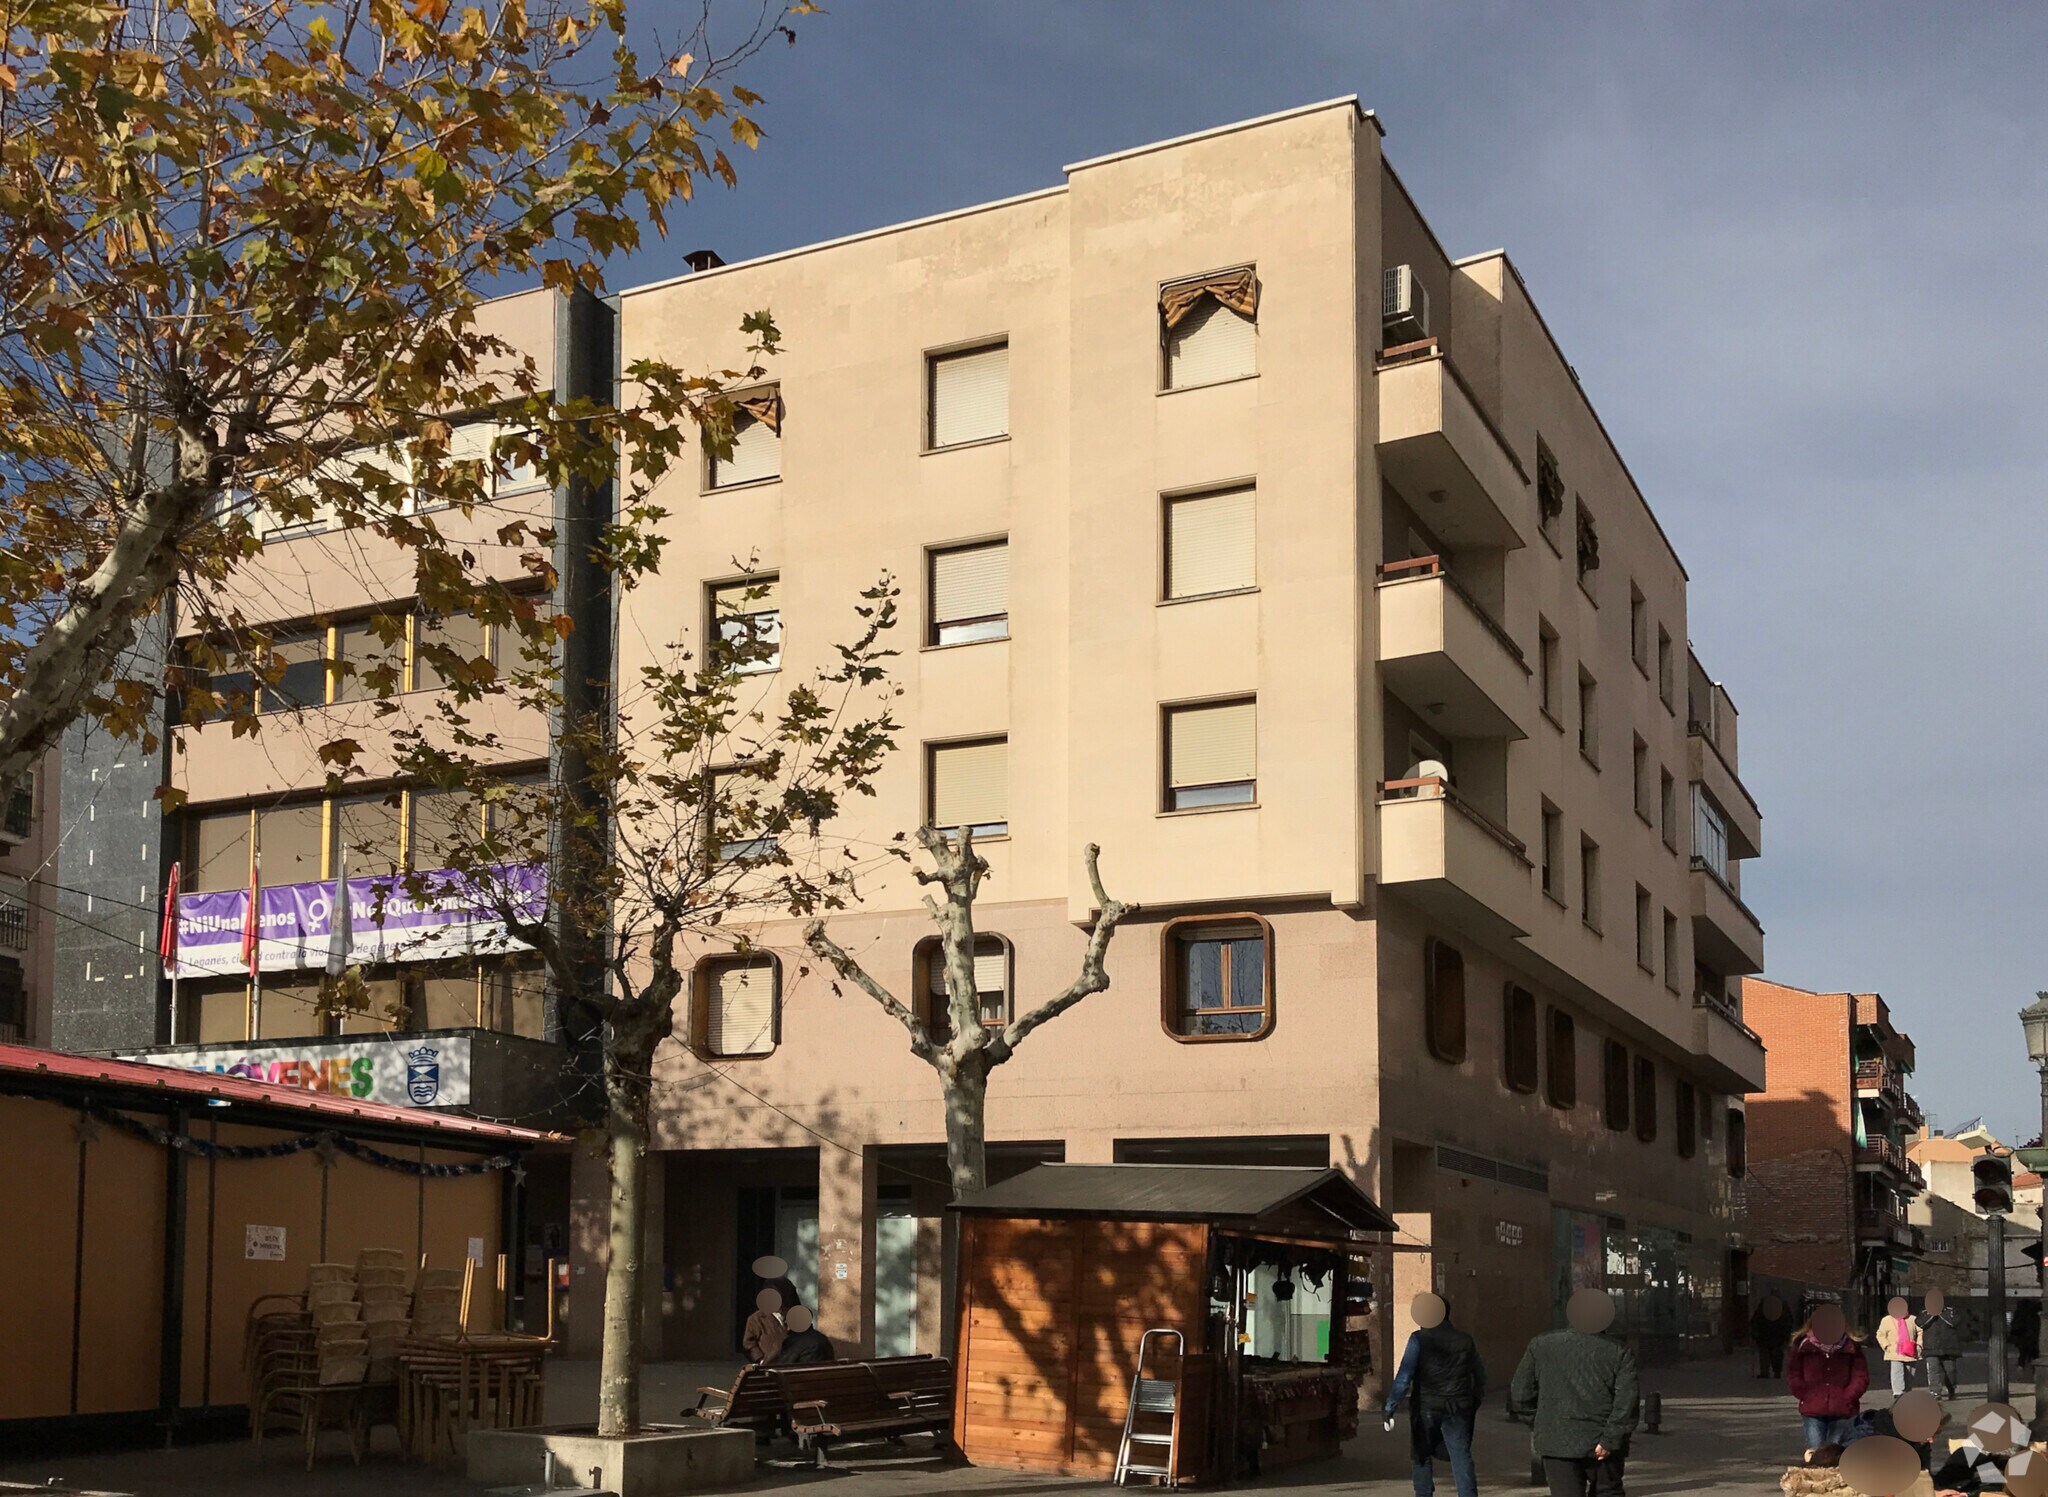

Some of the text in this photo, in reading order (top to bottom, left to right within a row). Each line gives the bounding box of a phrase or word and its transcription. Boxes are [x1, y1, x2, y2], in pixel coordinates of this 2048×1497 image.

[189, 954, 229, 967] Leganés,
[231, 951, 263, 965] cid
[265, 949, 296, 961] contra
[297, 947, 307, 958] la
[371, 940, 405, 955] géne
